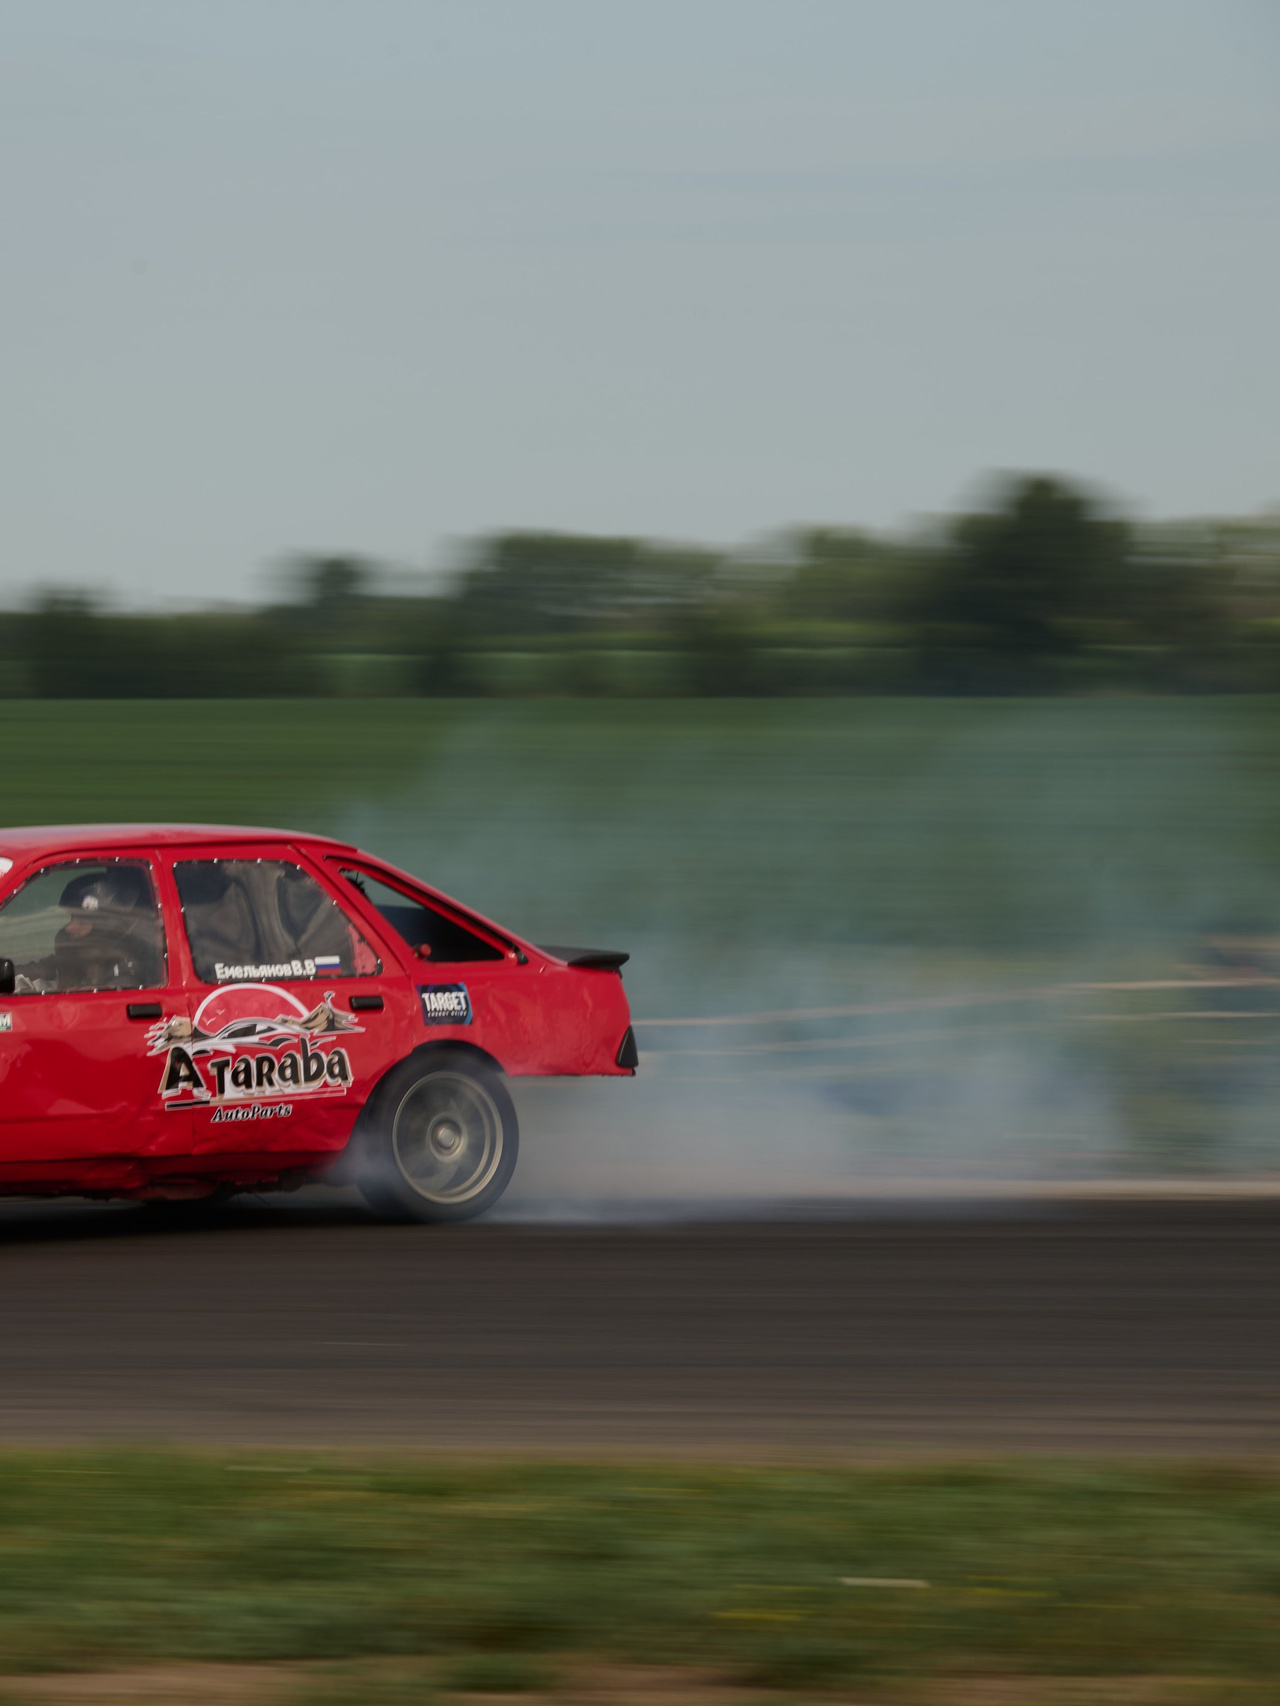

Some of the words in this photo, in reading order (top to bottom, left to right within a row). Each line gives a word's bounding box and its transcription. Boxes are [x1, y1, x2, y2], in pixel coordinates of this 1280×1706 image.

[214, 963, 292, 979] Емельянов
[421, 991, 467, 1012] TARGET
[210, 1102, 293, 1124] AutoParts
